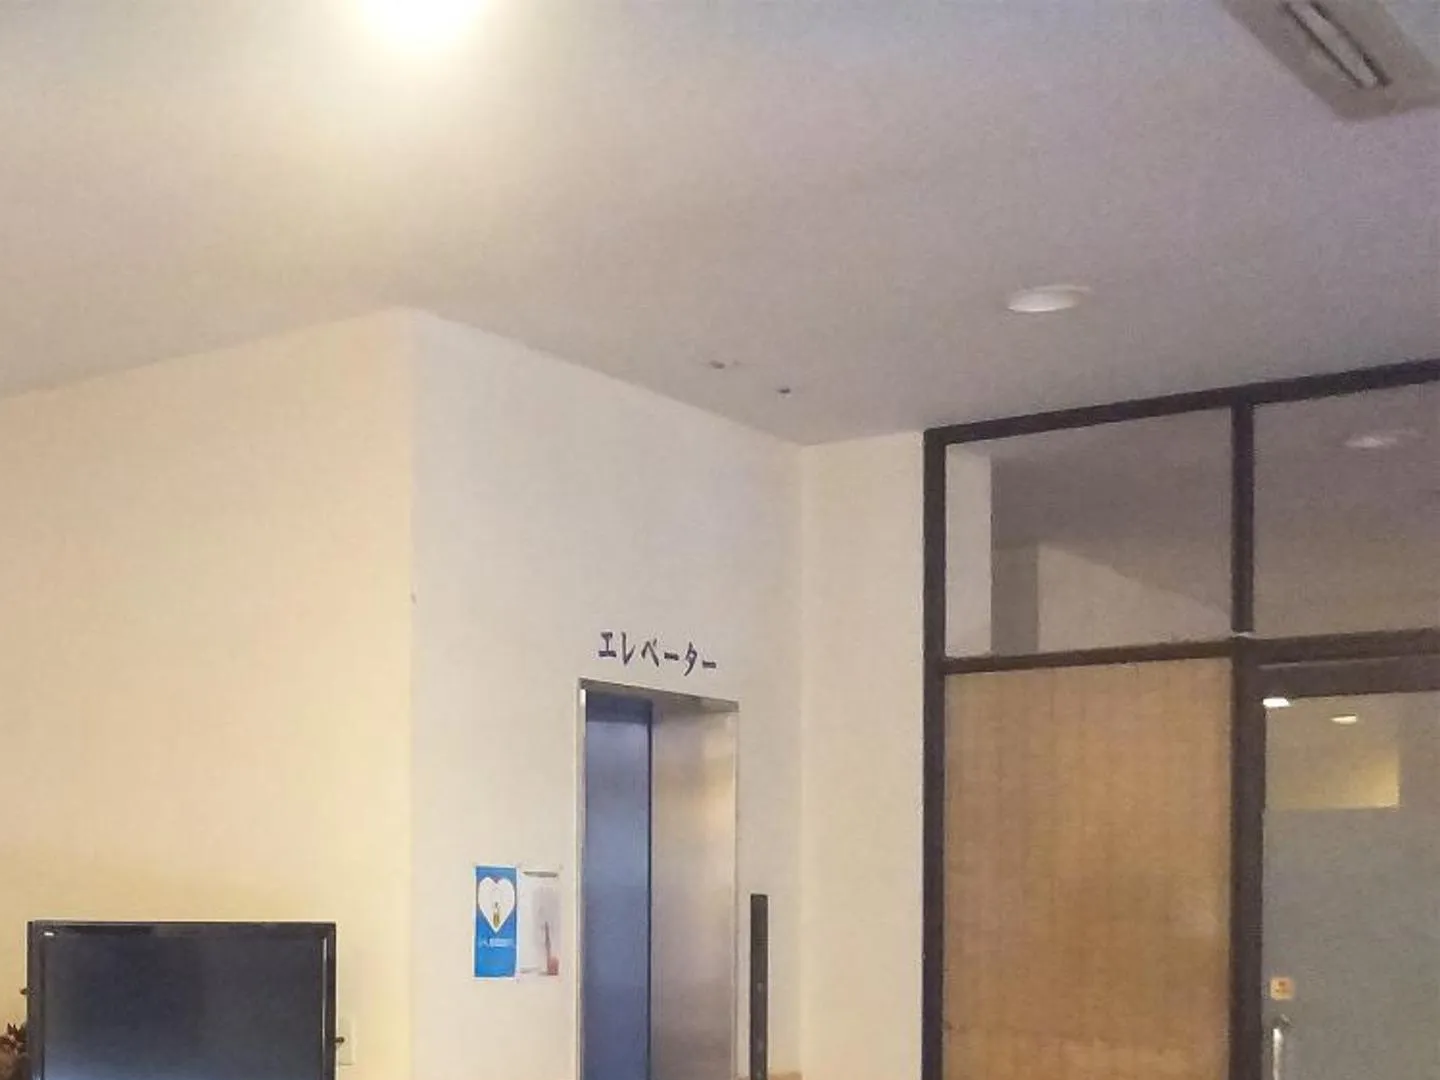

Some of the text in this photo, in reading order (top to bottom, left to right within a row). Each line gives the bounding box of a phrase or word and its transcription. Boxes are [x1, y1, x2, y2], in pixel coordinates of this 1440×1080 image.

[598, 631, 717, 677] エレベーター
